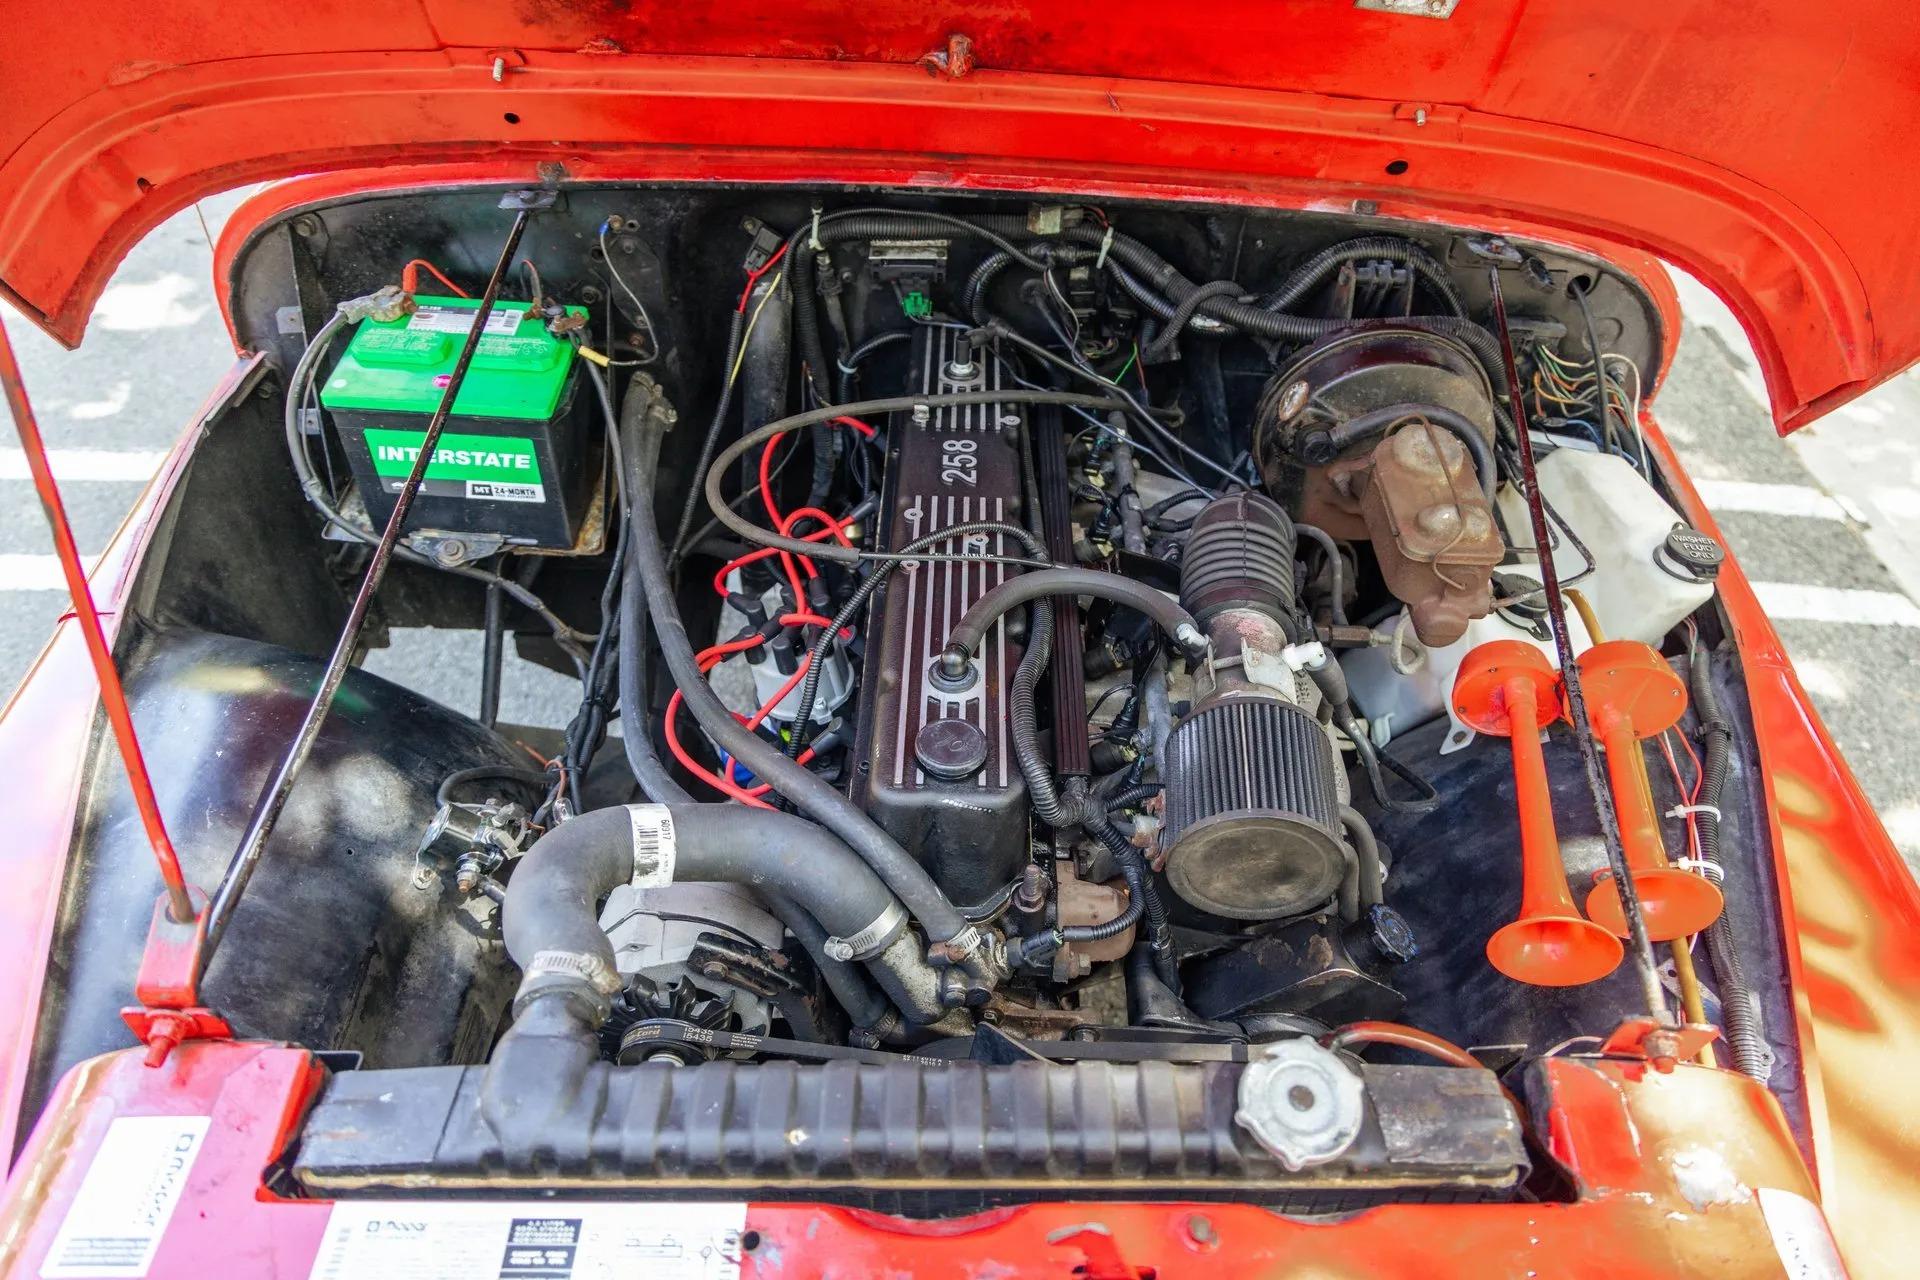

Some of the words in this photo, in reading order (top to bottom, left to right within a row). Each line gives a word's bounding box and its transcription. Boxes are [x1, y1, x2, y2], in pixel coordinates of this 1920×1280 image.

[941, 439, 977, 485] 258
[494, 487, 536, 496] 24-MONTH
[1672, 534, 1716, 546] WASHER
[1682, 542, 1713, 552] FLUID
[1689, 551, 1713, 559] ONLY
[683, 1032, 713, 1043] 15435
